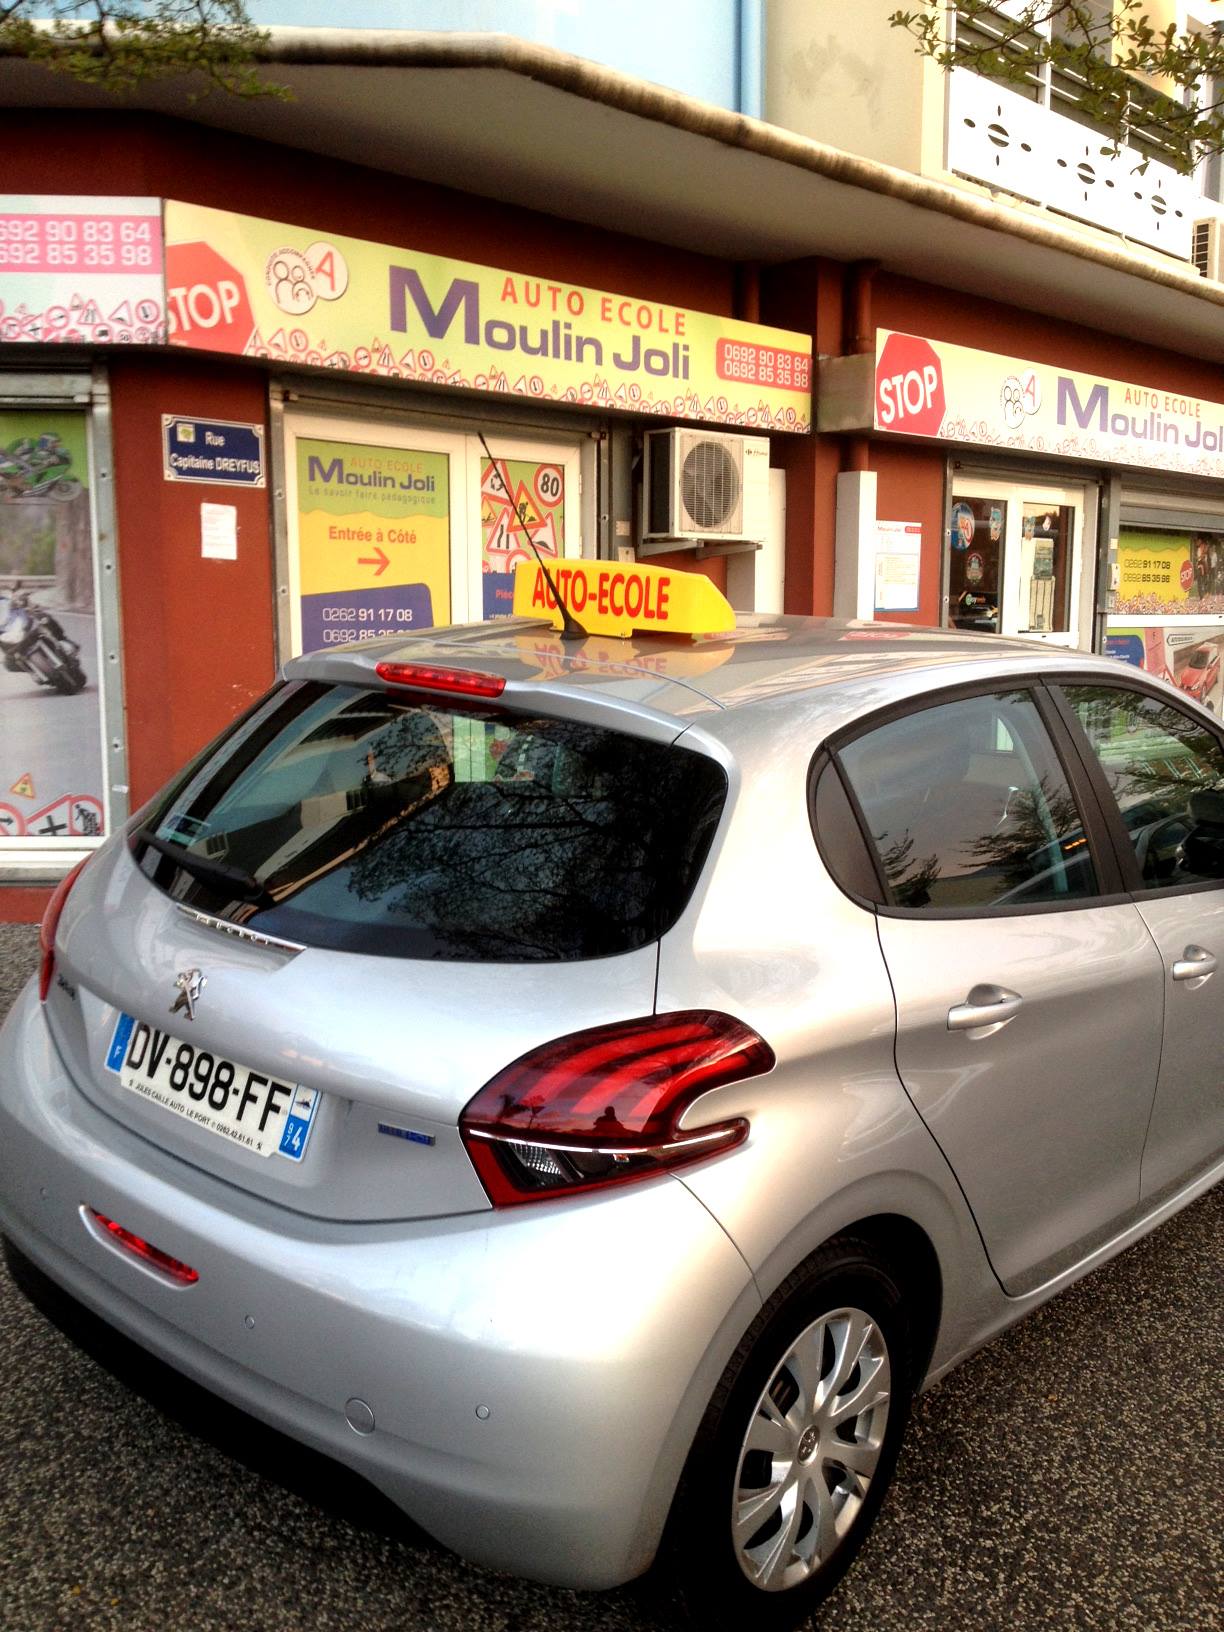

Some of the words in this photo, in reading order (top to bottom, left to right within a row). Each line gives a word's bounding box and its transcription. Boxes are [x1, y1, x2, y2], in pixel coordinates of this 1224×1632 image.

[46, 221, 77, 241] 90
[83, 221, 114, 242] 83
[120, 222, 150, 242] 64
[47, 244, 77, 264] 85
[84, 244, 115, 265] 35
[121, 245, 152, 265] 98
[315, 250, 335, 292] A
[499, 276, 585, 316] AUTO
[600, 297, 687, 337] ECOLE
[389, 264, 603, 367] Moulin
[612, 335, 690, 380] Joli
[724, 343, 756, 364] 0692
[759, 350, 774, 367] 90
[777, 353, 791, 369] 83
[794, 356, 808, 372] 64
[724, 360, 756, 380] 0692
[759, 366, 774, 382] 85
[777, 369, 791, 385] 35
[794, 372, 808, 388] 98
[879, 364, 938, 424] STOP
[1124, 388, 1158, 409] AUTO
[1165, 396, 1201, 418] ECOLE
[1057, 375, 1179, 445] Moulin
[205, 431, 225, 446] Rue
[170, 453, 214, 470] Capitaine
[215, 457, 260, 473] DREYFUS
[308, 455, 396, 488] Moulin
[399, 474, 435, 492] Joli
[540, 472, 560, 497] 80
[329, 526, 372, 541] Entrée
[376, 528, 383, 542] à
[388, 528, 416, 544] Côté
[532, 566, 671, 620] AUTO-ECOLE
[322, 608, 356, 621] 0262
[358, 608, 374, 621] 91
[378, 608, 394, 621] 17
[396, 608, 413, 622] 08
[323, 629, 357, 642] 0692
[126, 1021, 292, 1132] DV-898-FF
[169, 1101, 186, 1114] AUTO
[186, 1109, 195, 1118] LE
[194, 1113, 211, 1126] PORT
